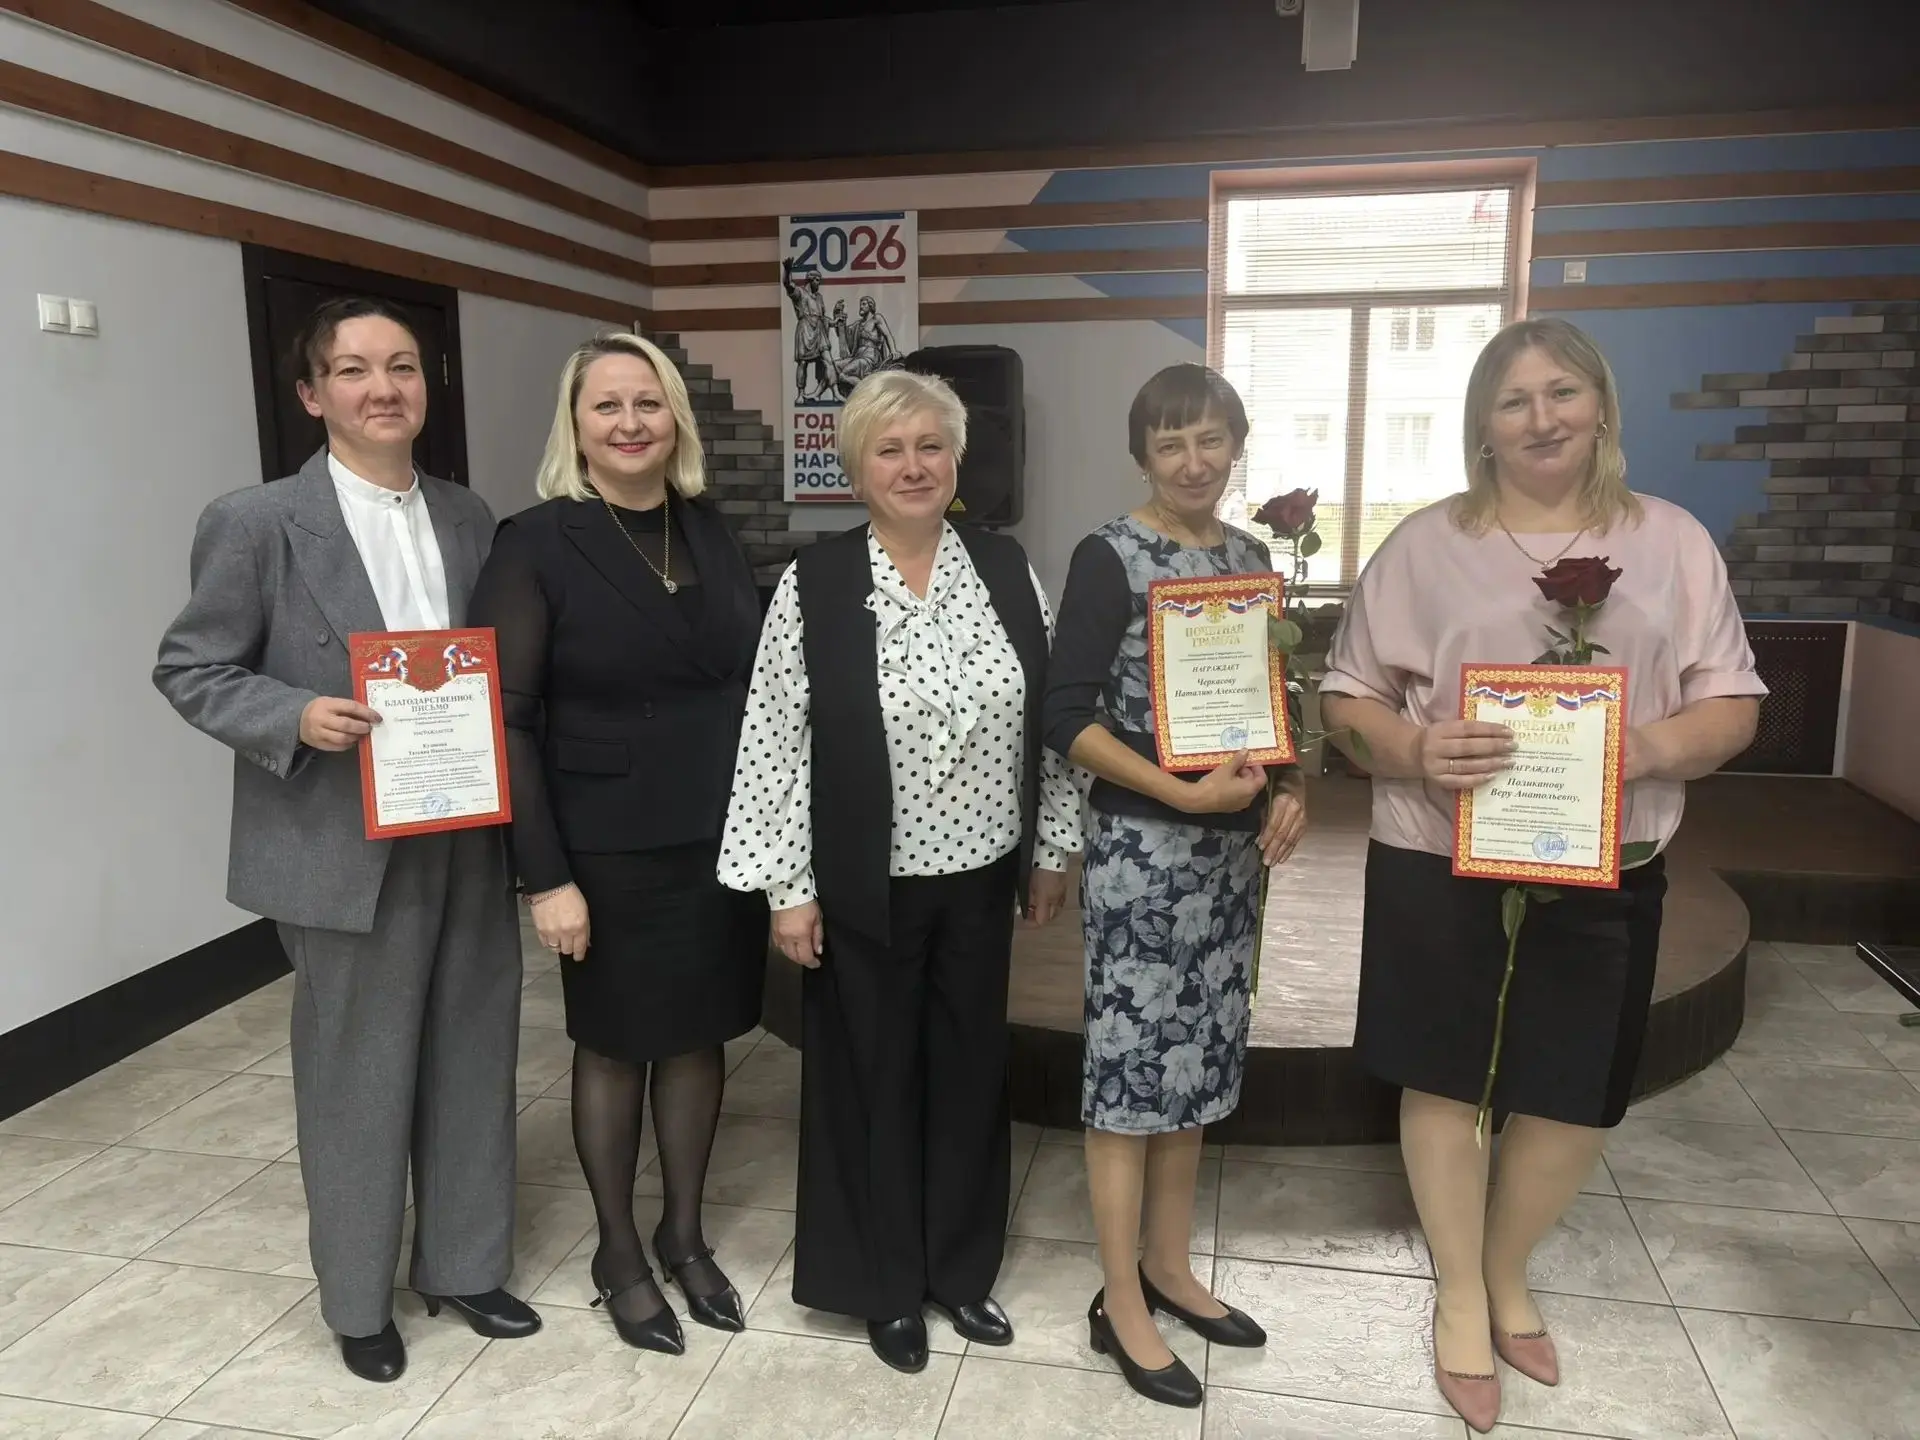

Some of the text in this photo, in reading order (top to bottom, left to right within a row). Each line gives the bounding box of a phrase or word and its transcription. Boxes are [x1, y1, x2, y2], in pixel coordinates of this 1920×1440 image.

[790, 225, 906, 272] 2026
[794, 413, 835, 431] ГОД
[795, 433, 839, 451] ЕДИ
[1192, 664, 1240, 673] НАГРАЖДАЕТ
[1197, 677, 1237, 687] Черкасову
[1174, 687, 1260, 698] Наталию Алексеевну,
[384, 694, 473, 707] БЛАГОДАРСТВЕННОЕ
[411, 703, 449, 712] ПИСЬМО
[1513, 731, 1570, 745] РАМОТА
[1507, 778, 1565, 791] Поликанову
[1490, 788, 1580, 803] Веру Анатольевну,
